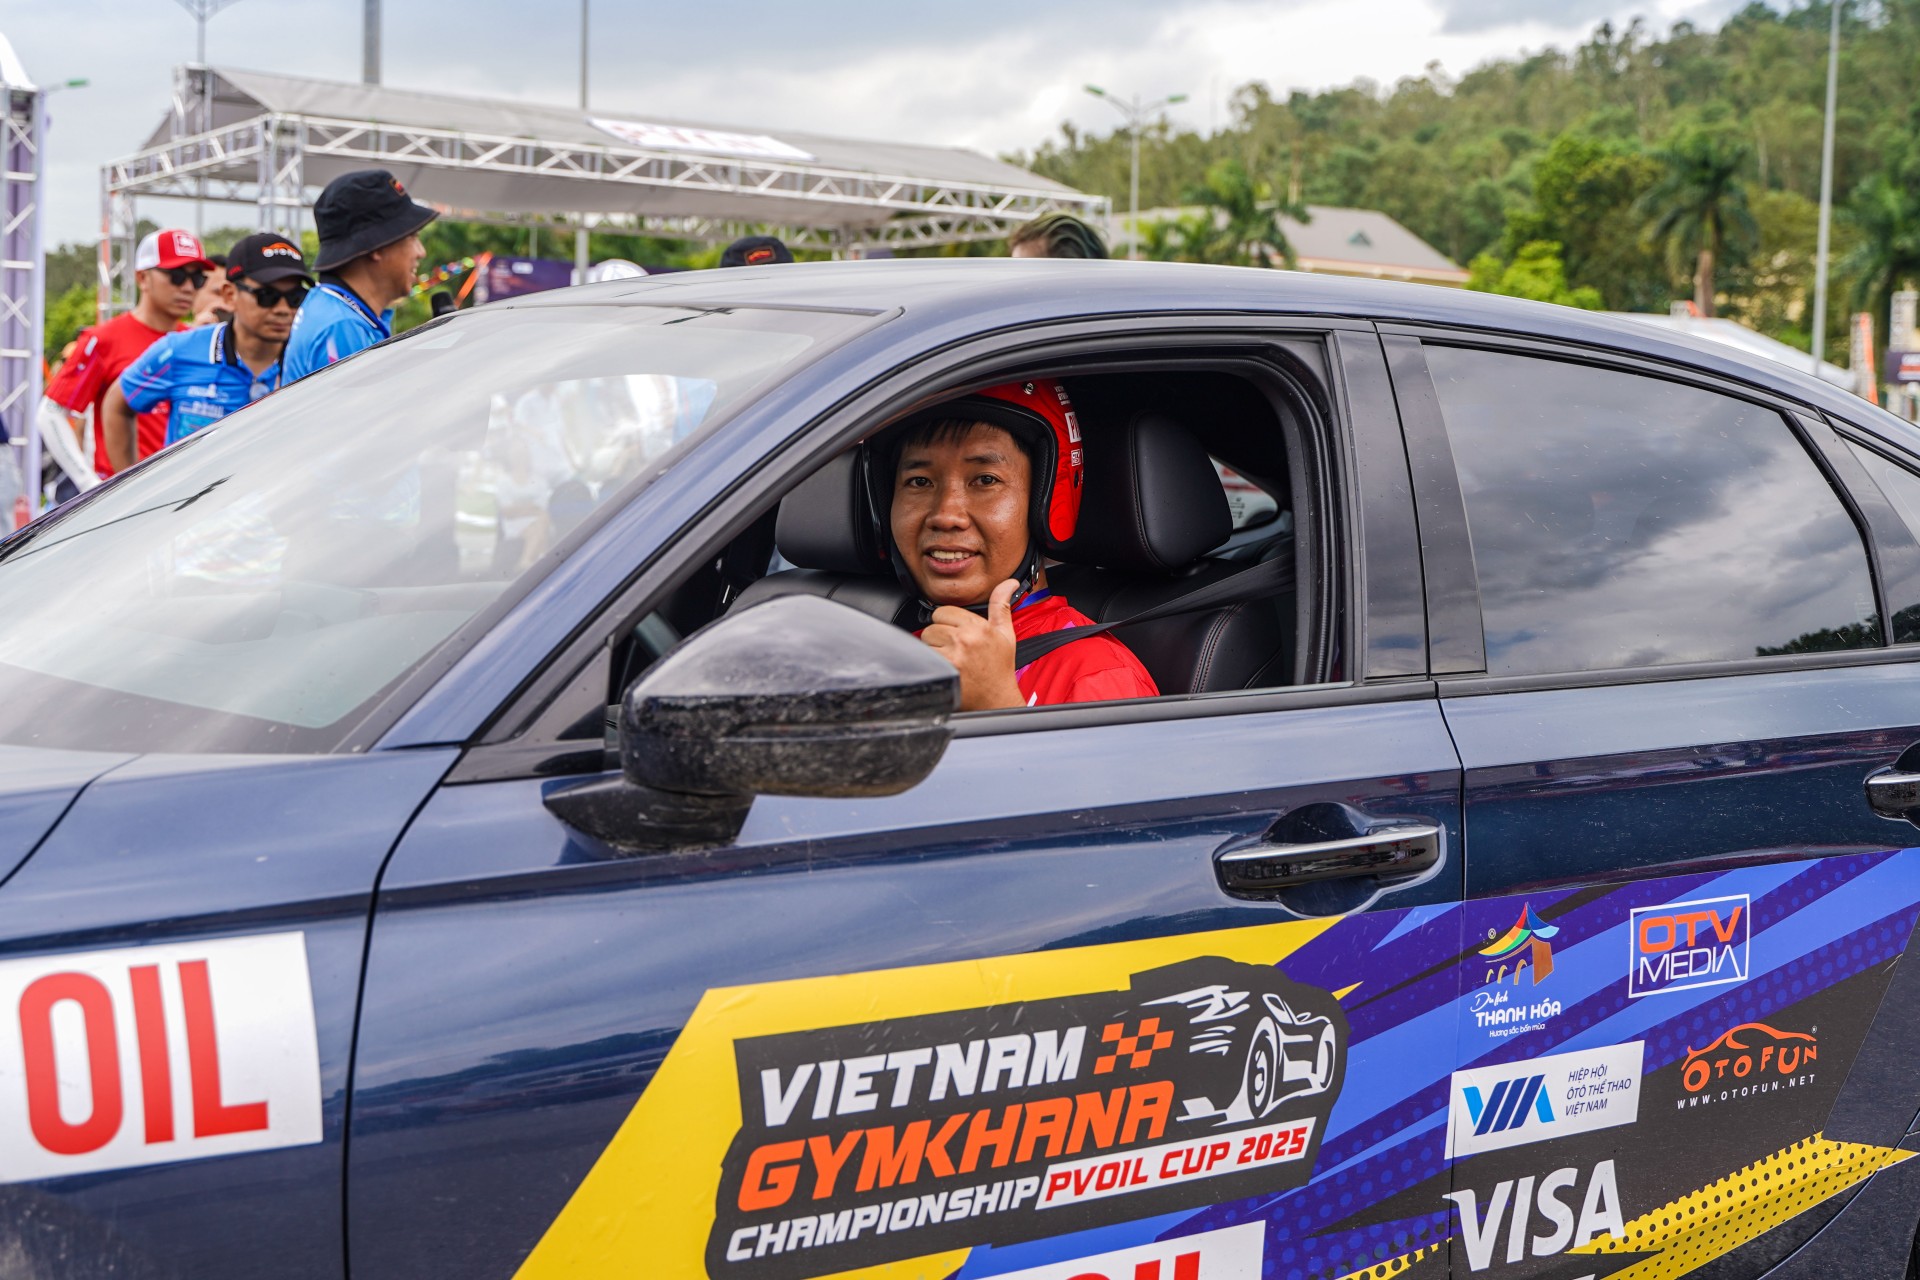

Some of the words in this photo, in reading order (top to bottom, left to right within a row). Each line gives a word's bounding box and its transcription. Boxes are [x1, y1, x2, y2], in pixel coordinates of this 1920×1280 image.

[1639, 906, 1743, 954] OTV
[1639, 944, 1743, 985] MEDIA
[1475, 1005, 1527, 1028] THANH
[1530, 997, 1562, 1020] HÓA
[18, 958, 269, 1156] OIL
[760, 1025, 1087, 1128] VIETNAM
[1568, 1067, 1590, 1083] HIỆP
[1590, 1063, 1608, 1079] HỘI
[1565, 1101, 1586, 1118] VIỆT
[1585, 1097, 1608, 1112] NAM
[1566, 1083, 1586, 1100] ÔTÔ
[1588, 1078, 1608, 1097] THỂ
[1606, 1078, 1632, 1093] THAO
[1676, 1073, 1816, 1110] WWW.OTOFUN.NET
[737, 1080, 1175, 1213] GYMKHANA
[726, 1175, 1040, 1262] CHAMPIONSHIP
[1044, 1157, 1152, 1202] PVOIL
[1159, 1141, 1231, 1180] CUP
[1236, 1126, 1308, 1165] 2025
[1442, 1159, 1626, 1272] VISA
